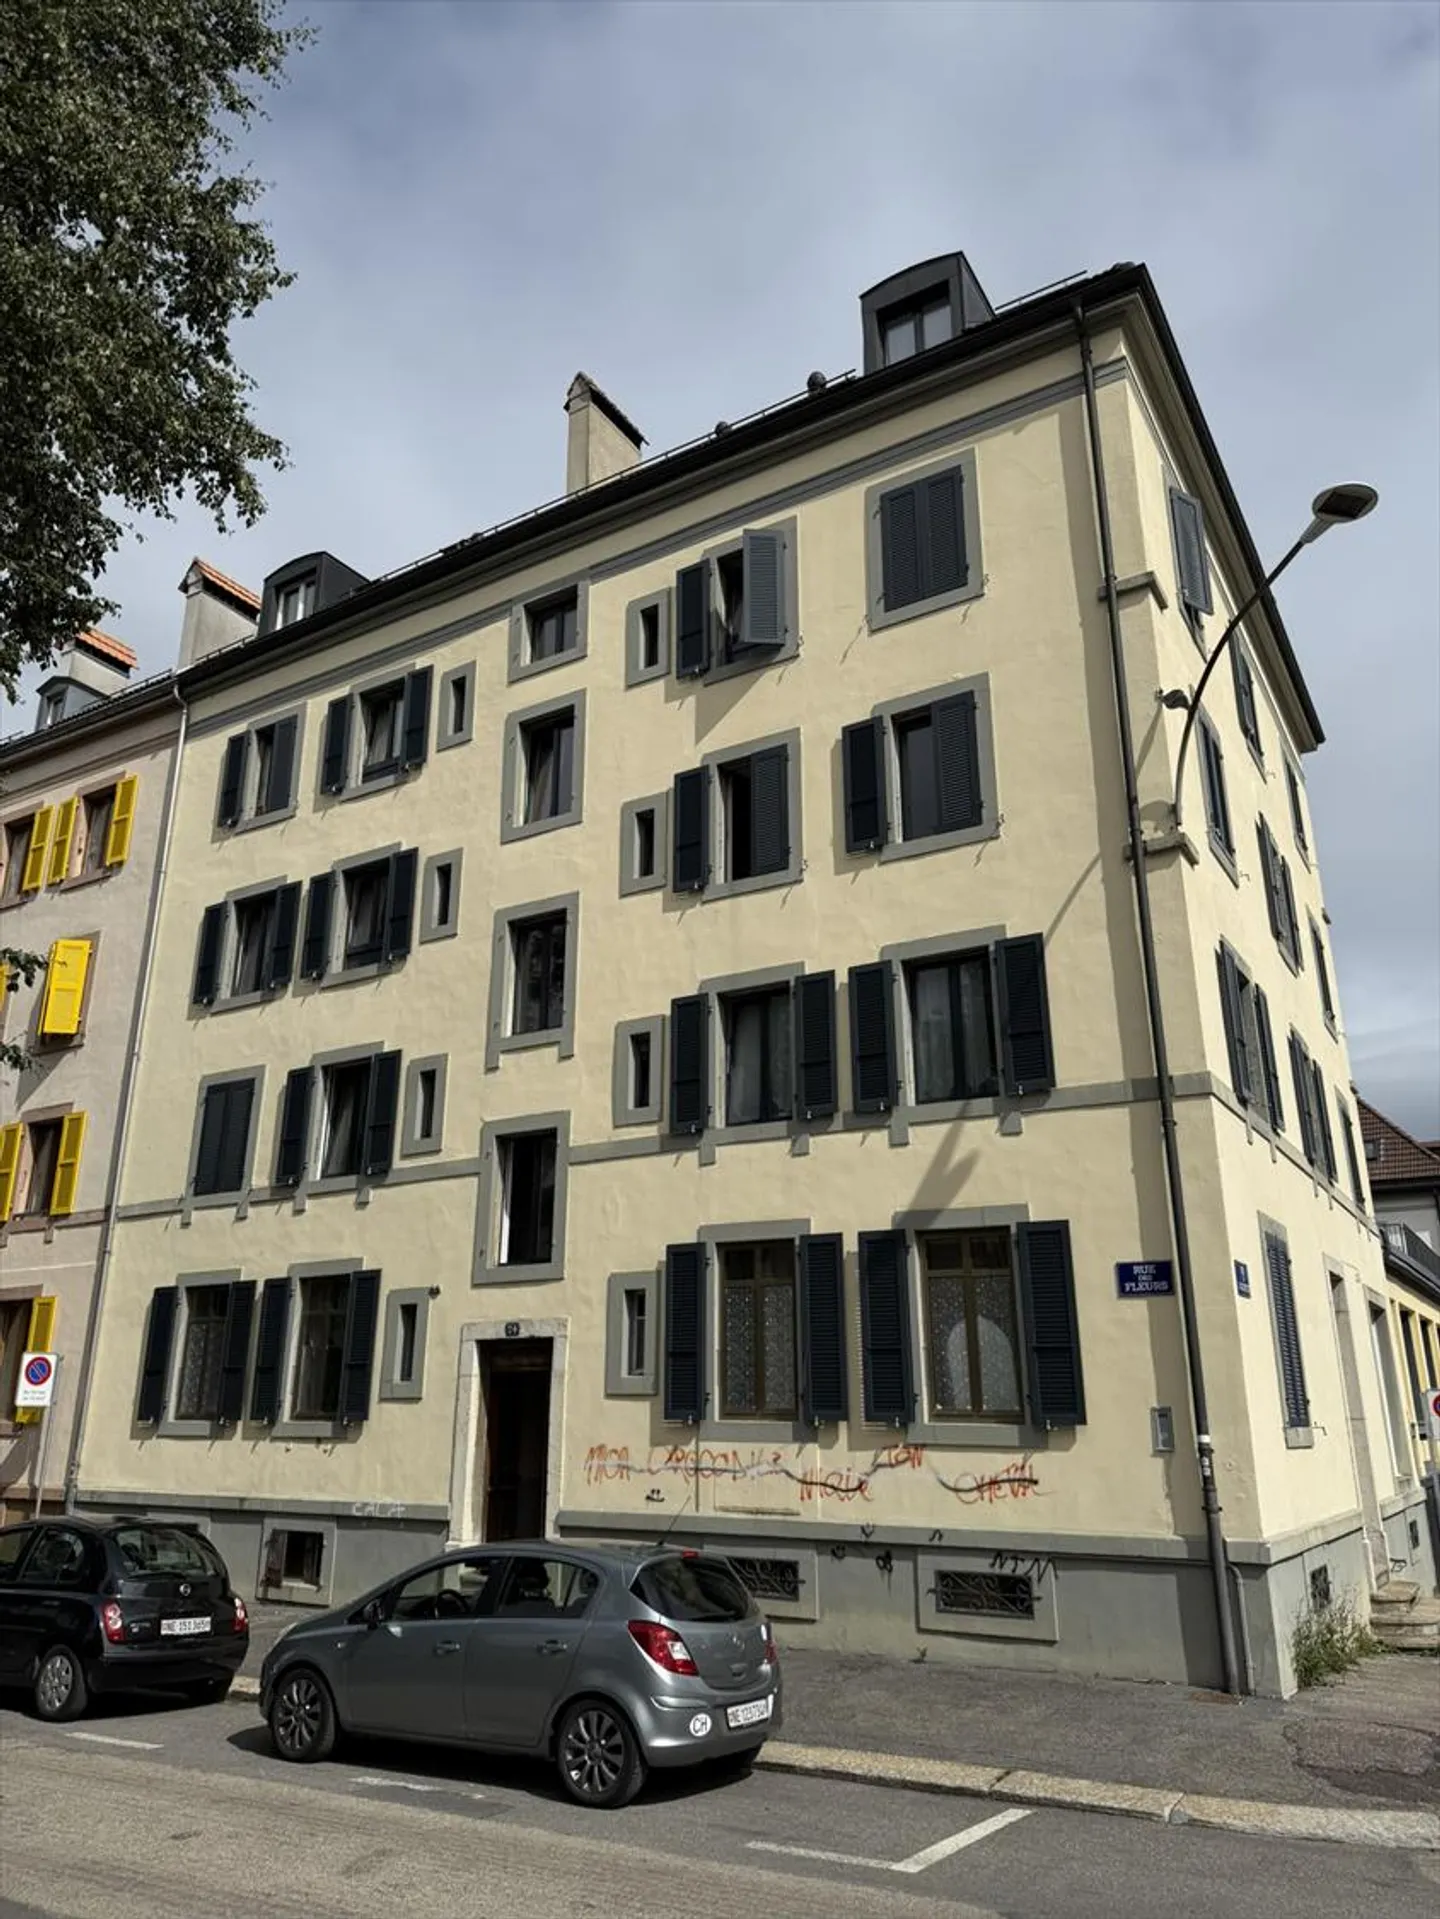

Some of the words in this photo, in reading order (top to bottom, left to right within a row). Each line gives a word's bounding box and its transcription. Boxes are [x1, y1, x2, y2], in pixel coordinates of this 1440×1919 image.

[1133, 1264, 1156, 1275] RUE
[1124, 1281, 1169, 1293] FLEURS
[692, 1716, 709, 1734] CH
